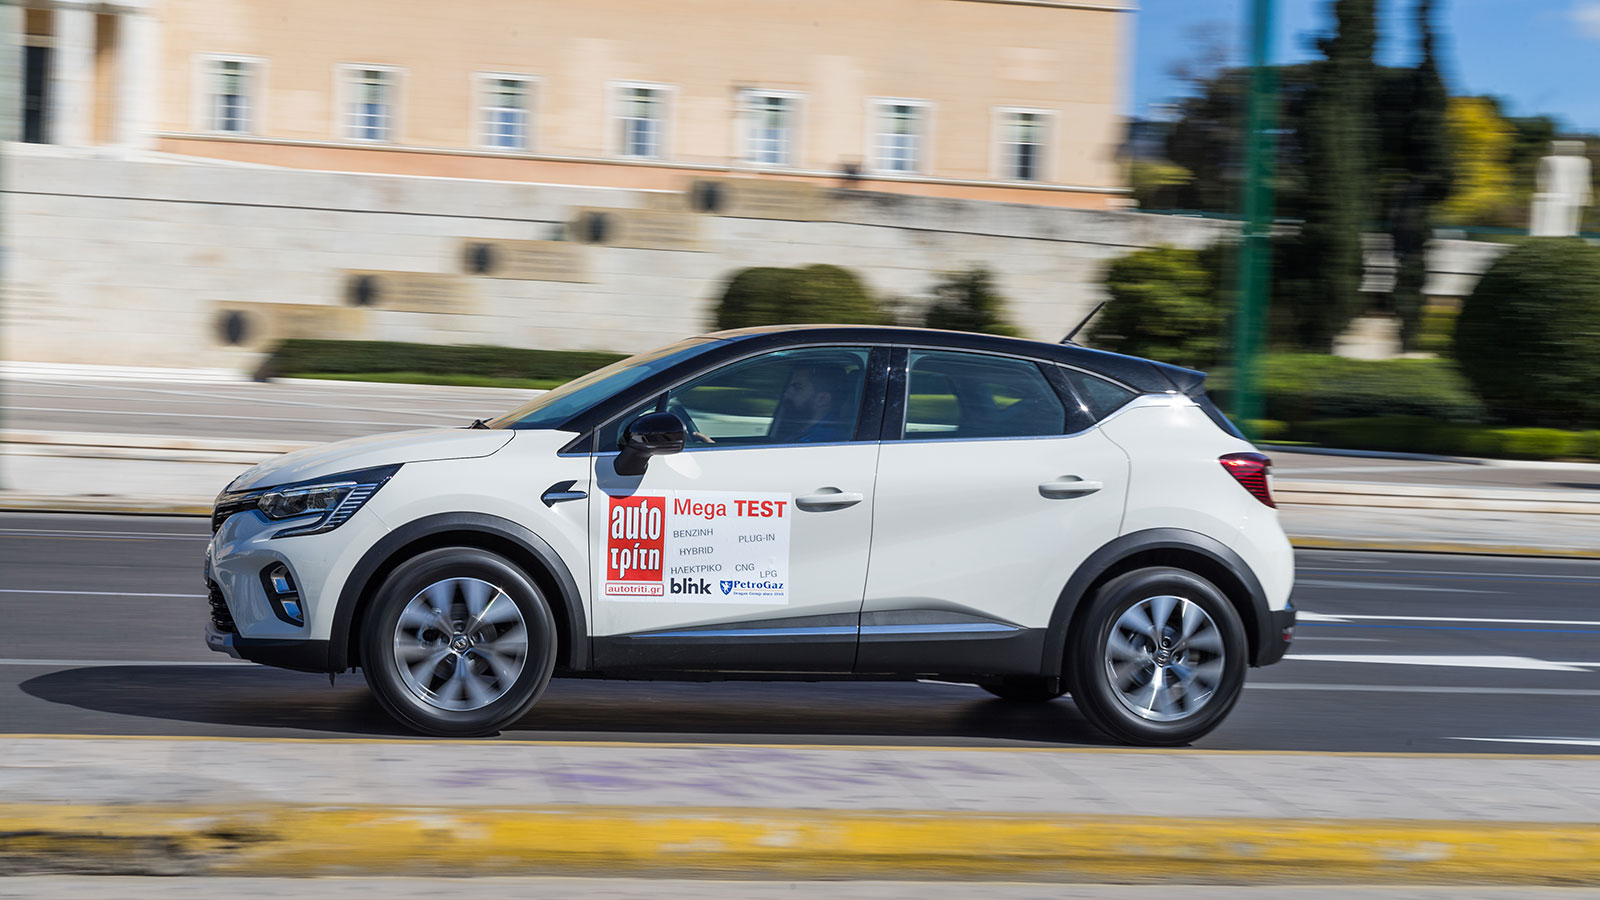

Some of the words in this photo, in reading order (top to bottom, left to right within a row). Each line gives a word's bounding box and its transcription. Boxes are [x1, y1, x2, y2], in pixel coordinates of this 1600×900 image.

[674, 498, 727, 519] Mega
[734, 500, 787, 517] TEST
[611, 499, 662, 540] auto
[673, 529, 713, 538] ΒΕΝΖΙΝΗ
[738, 534, 775, 543] PLUG-IN
[679, 547, 713, 555] HYBRID
[610, 543, 660, 579] τρίτη
[671, 564, 722, 574] ΗΛΕΚΤΡΙΚΟ
[735, 563, 755, 572] CNG
[760, 570, 777, 578] LPG
[670, 578, 711, 595] blink
[734, 580, 784, 590] PetroGaz
[608, 585, 661, 596] autotriti.gr
